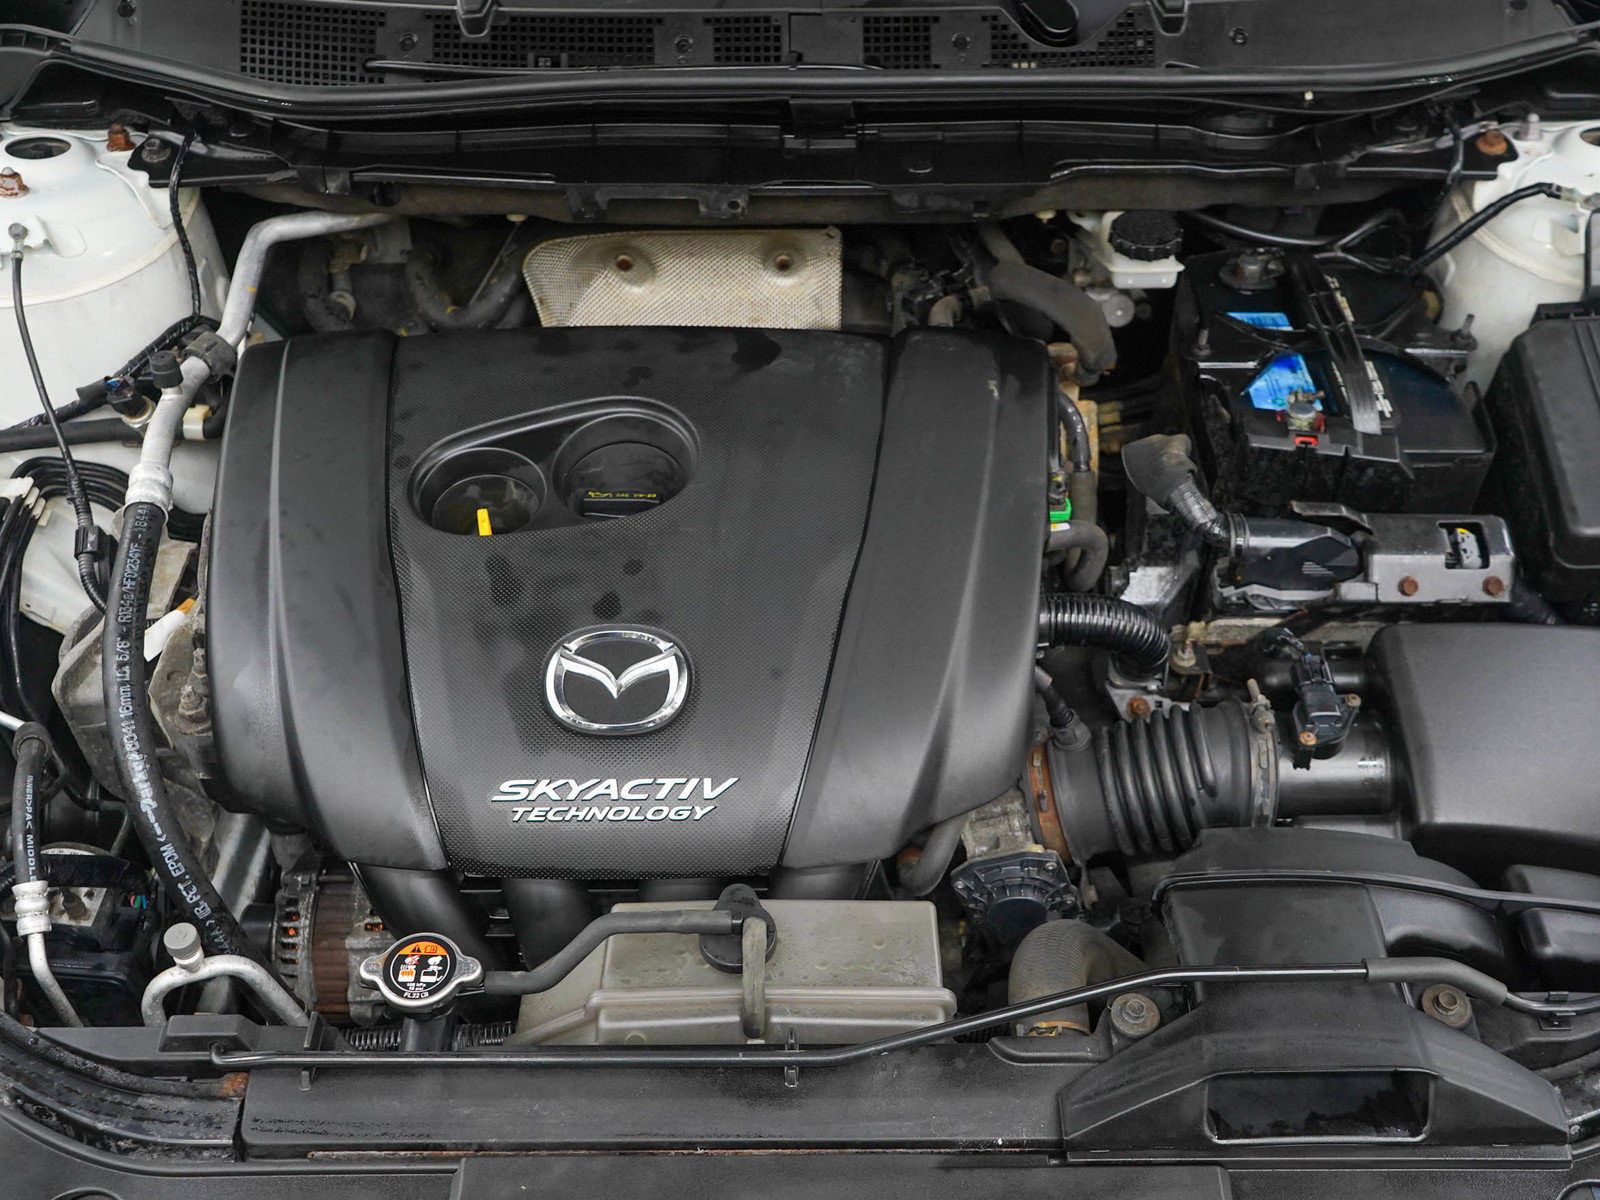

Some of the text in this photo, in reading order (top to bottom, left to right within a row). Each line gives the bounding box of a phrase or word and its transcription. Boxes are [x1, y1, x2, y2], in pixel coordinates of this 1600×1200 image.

[119, 684, 134, 718] 16mm
[491, 777, 741, 802] SKYACTIV
[511, 805, 718, 823] TECHNOLOGY
[160, 843, 186, 878] EPDM
